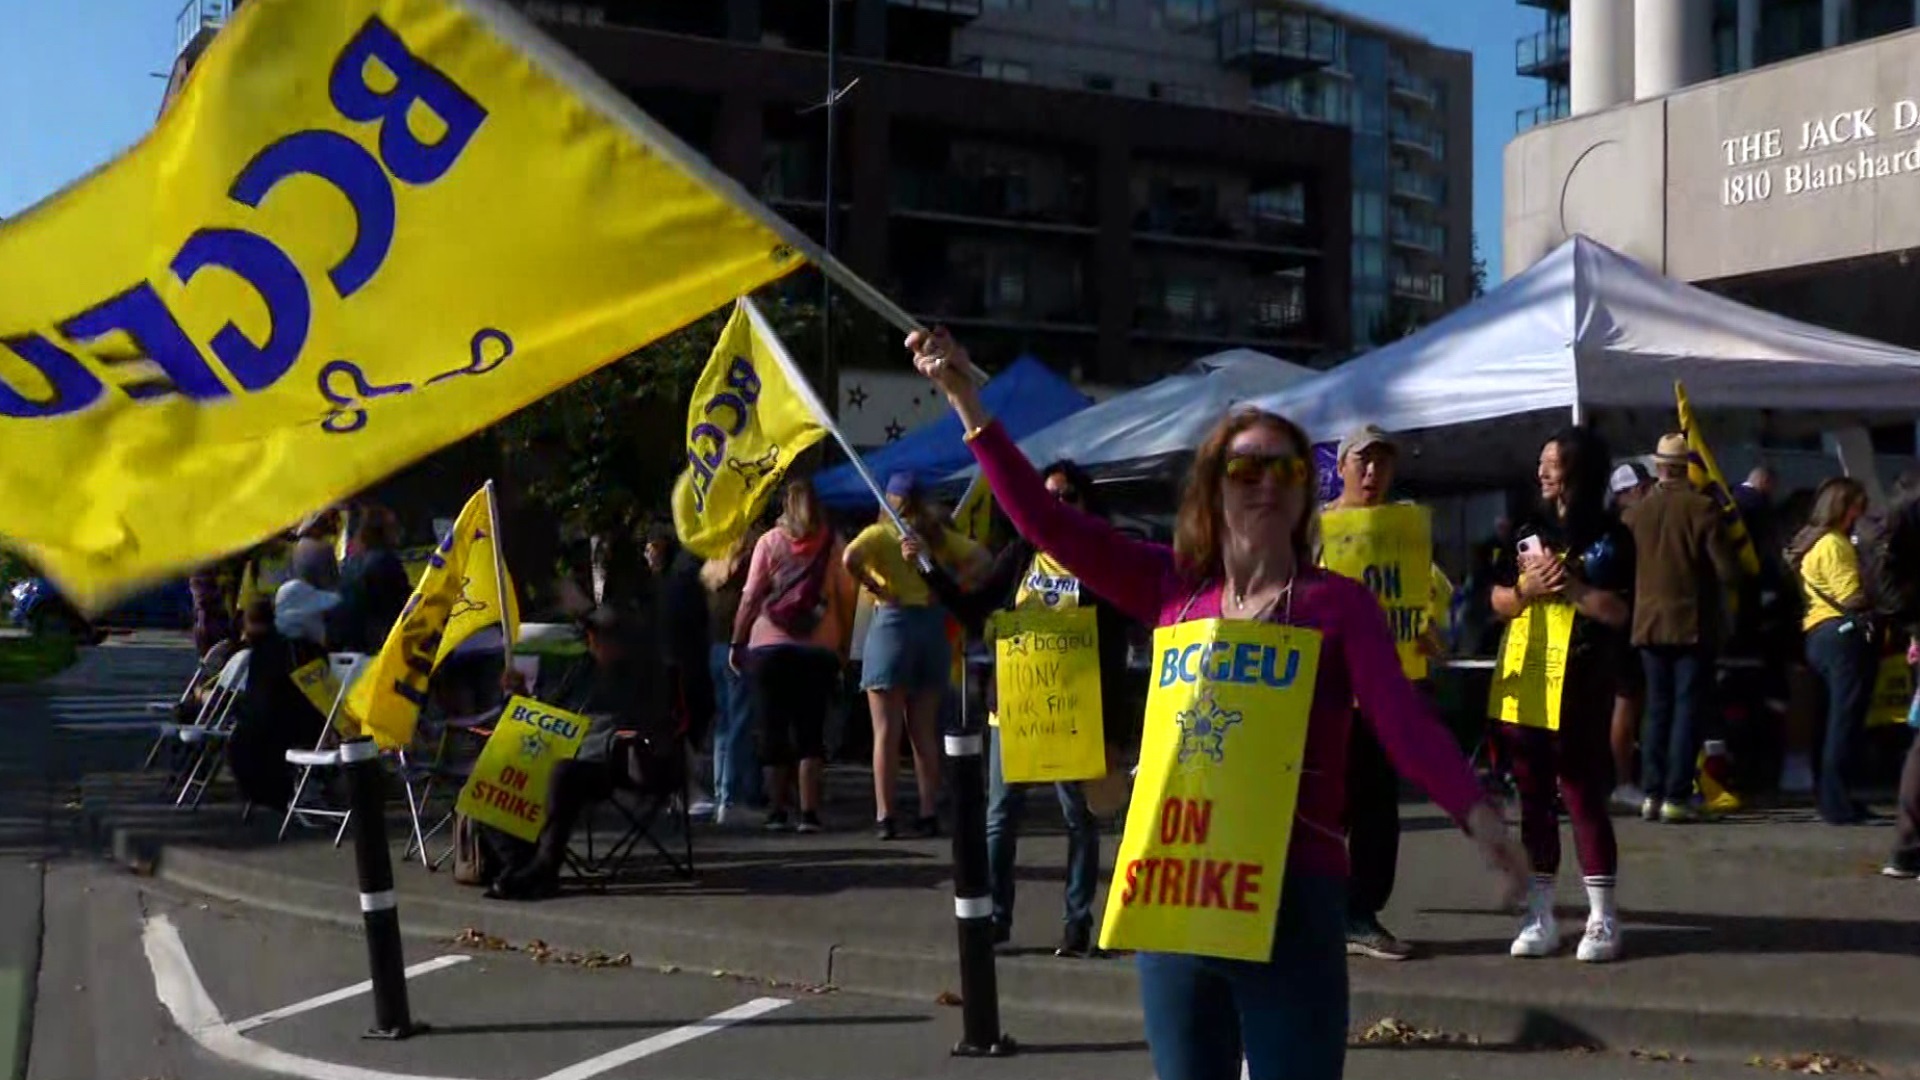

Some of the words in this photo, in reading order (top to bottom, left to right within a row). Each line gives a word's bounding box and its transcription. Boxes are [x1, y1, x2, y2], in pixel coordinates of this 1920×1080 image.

[1722, 128, 1783, 166] THE
[1798, 107, 1877, 151] JACK
[1894, 100, 1920, 131] D
[1724, 170, 1772, 206] 1810
[1784, 138, 1920, 195] Blanshard
[1034, 631, 1093, 655] bcgeu
[1159, 641, 1301, 688] BCGEU
[512, 705, 580, 739] BCGEU
[471, 780, 542, 823] STRIKE
[500, 765, 529, 792] ON
[1160, 796, 1212, 845] ON
[1121, 857, 1263, 914] STRIKE
